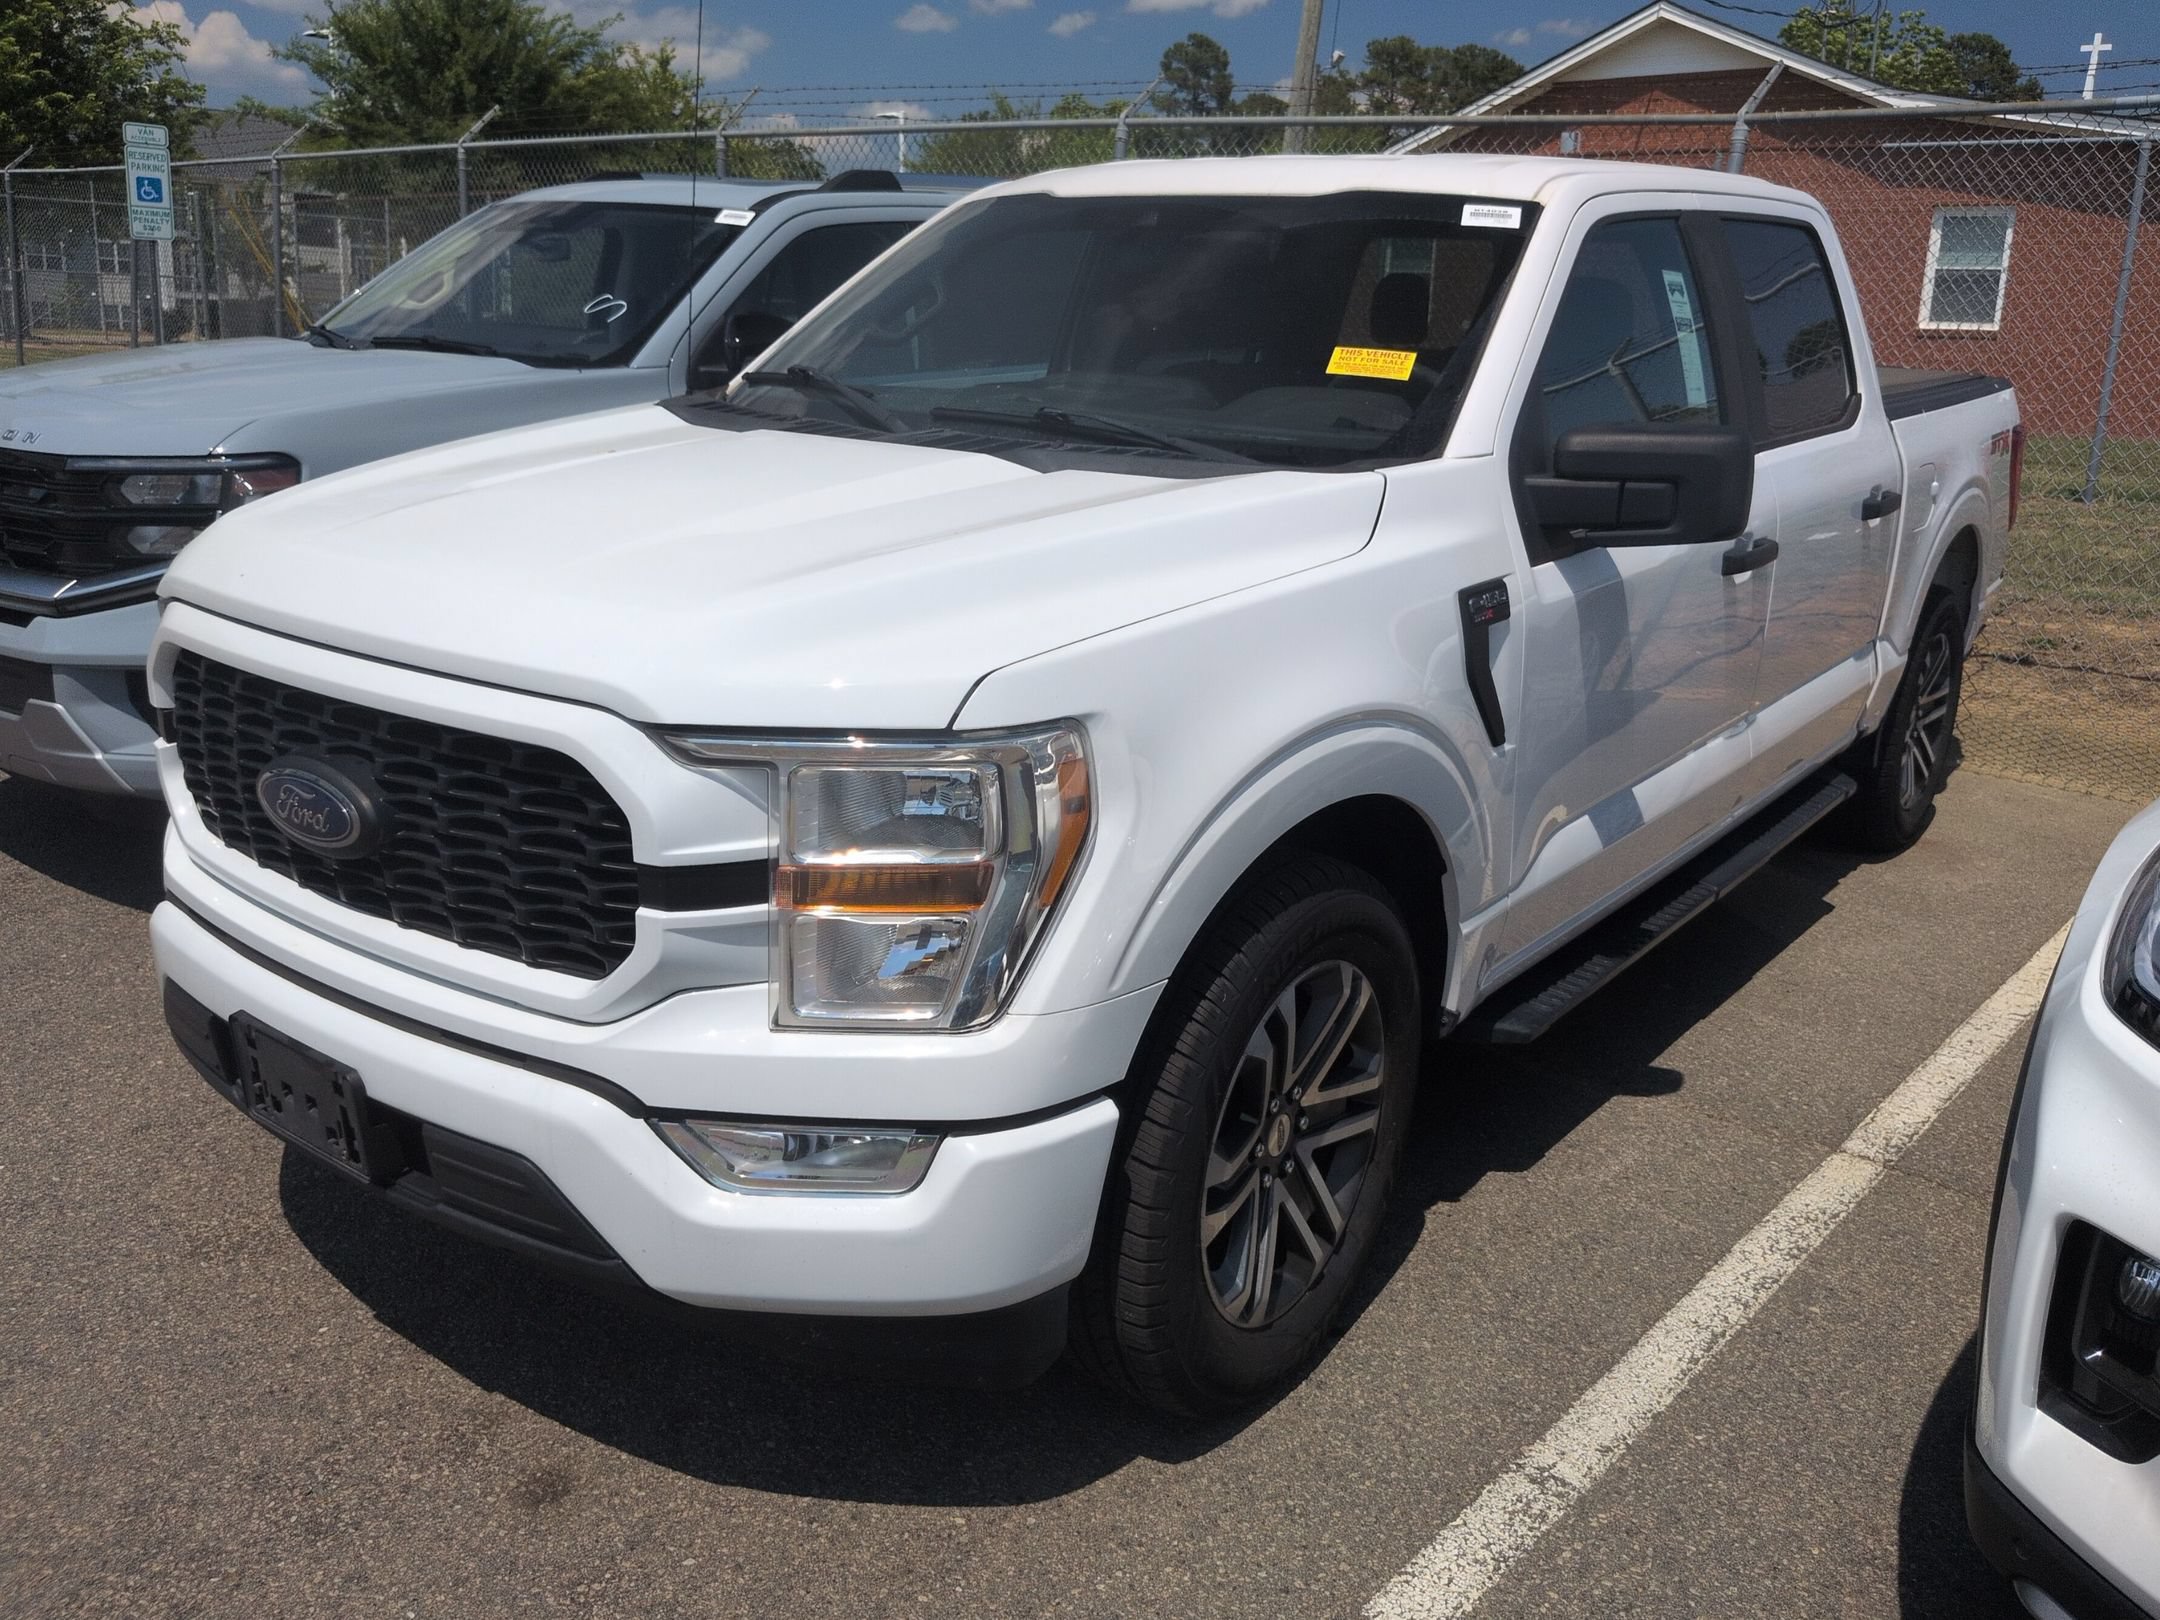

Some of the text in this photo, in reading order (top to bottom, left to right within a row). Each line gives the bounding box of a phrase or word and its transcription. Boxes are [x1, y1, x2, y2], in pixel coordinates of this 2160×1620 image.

[138, 128, 154, 137] VAN
[128, 150, 167, 163] RESERVED
[131, 161, 166, 174] PARKING
[132, 208, 170, 218] MAXIMUM
[133, 216, 170, 225] PENALTY
[1339, 348, 1411, 361] THIS VEHICLE
[1382, 359, 1406, 367] SALE
[276, 784, 331, 832] Ford
